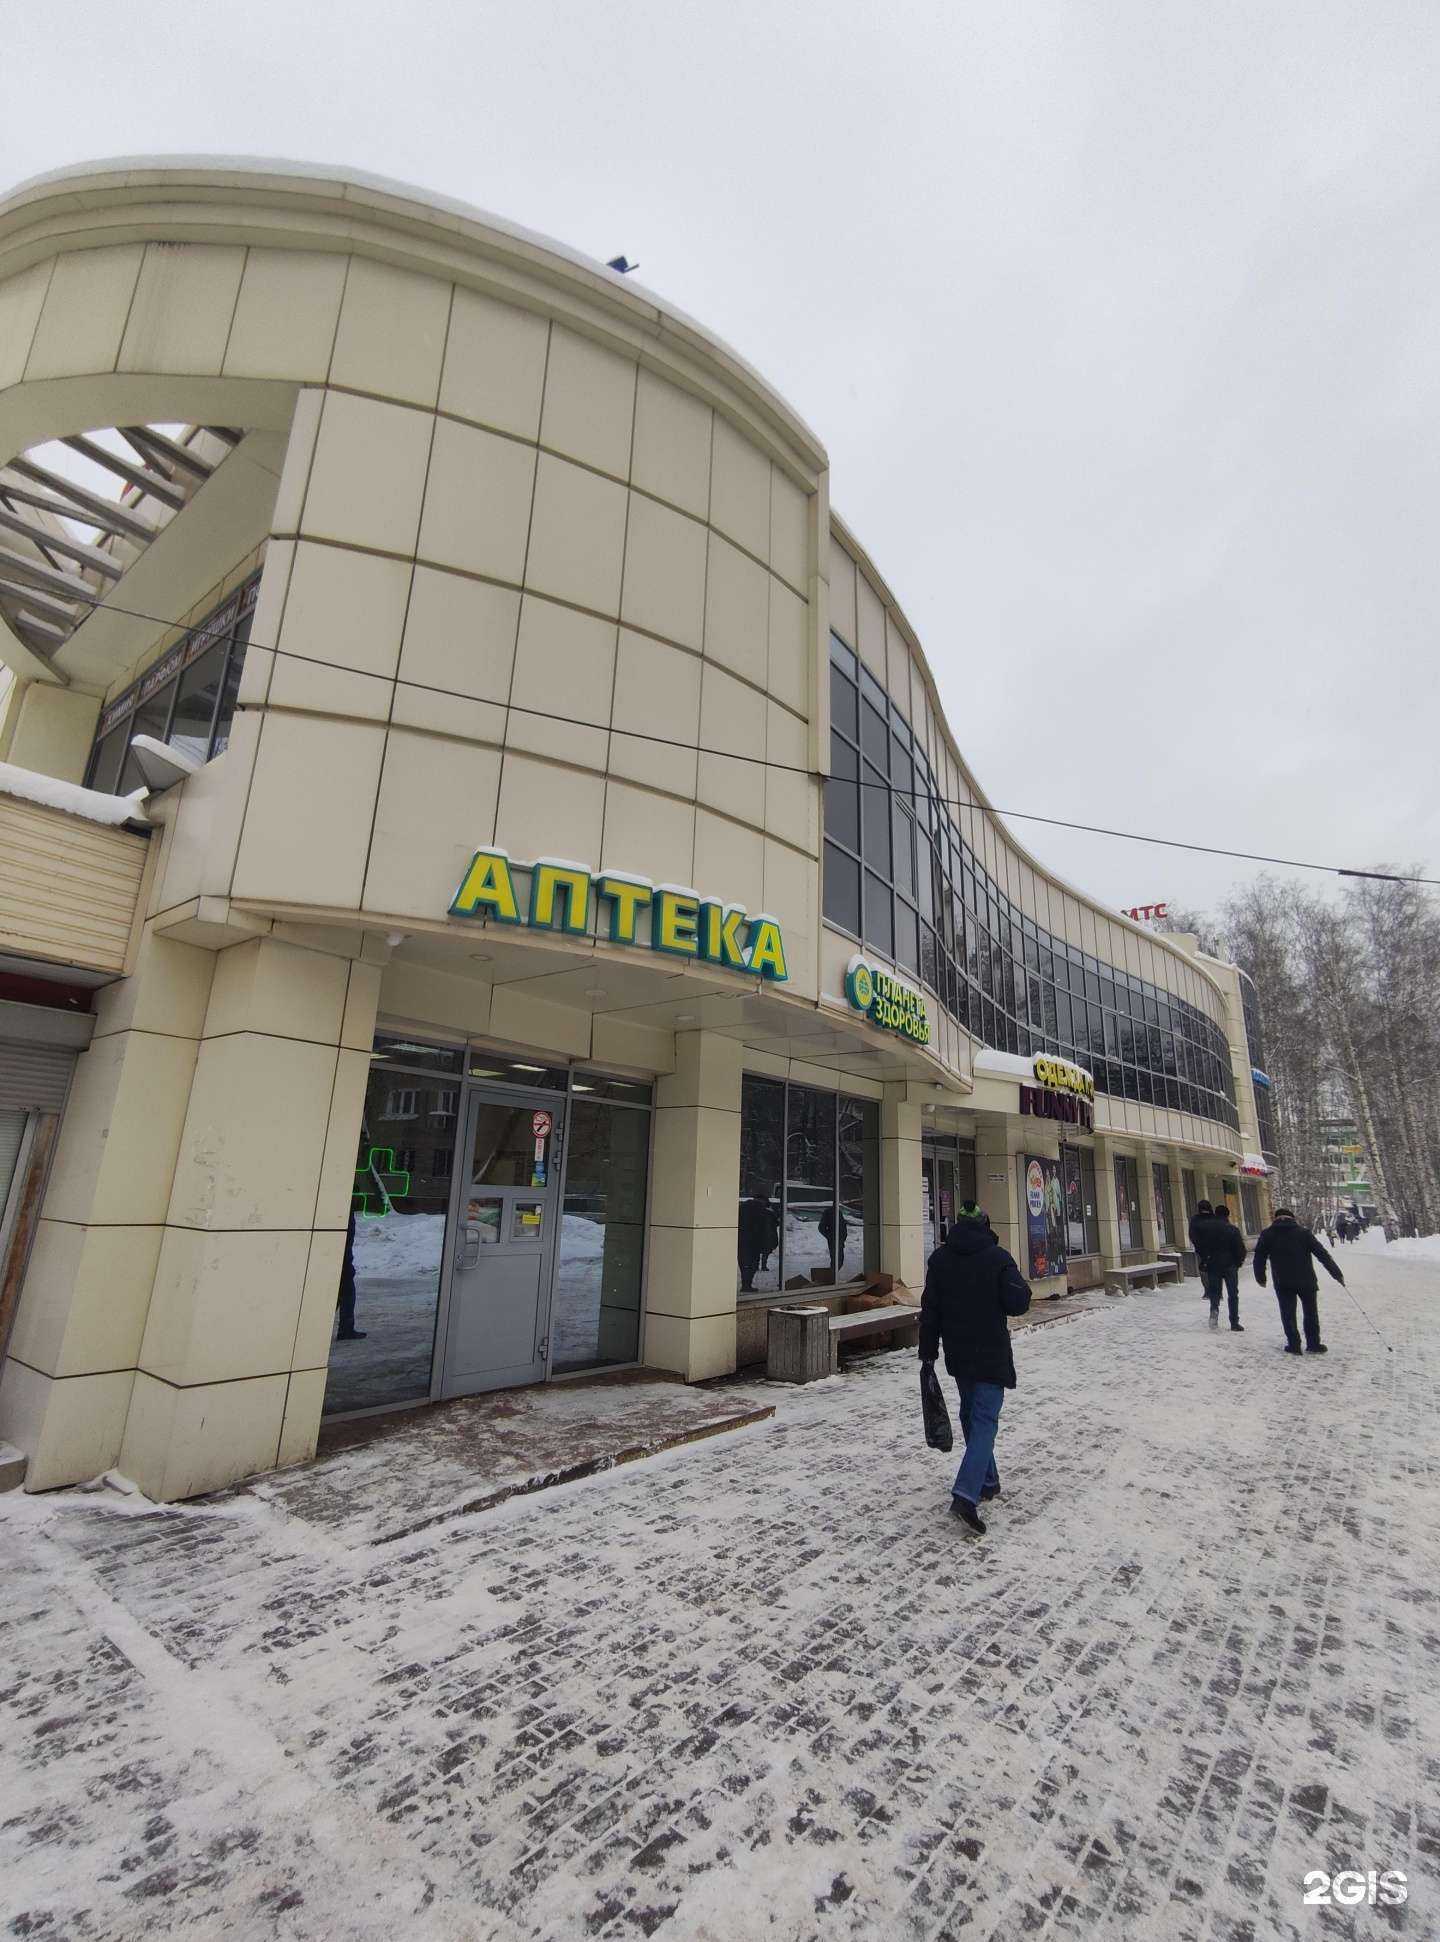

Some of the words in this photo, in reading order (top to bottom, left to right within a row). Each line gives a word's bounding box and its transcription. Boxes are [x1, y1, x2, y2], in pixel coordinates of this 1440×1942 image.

[448, 851, 788, 982] АПТЕКА
[875, 972, 928, 1018] ПЛАНЕТА
[875, 997, 930, 1043] ЗДОРОВЬЯ
